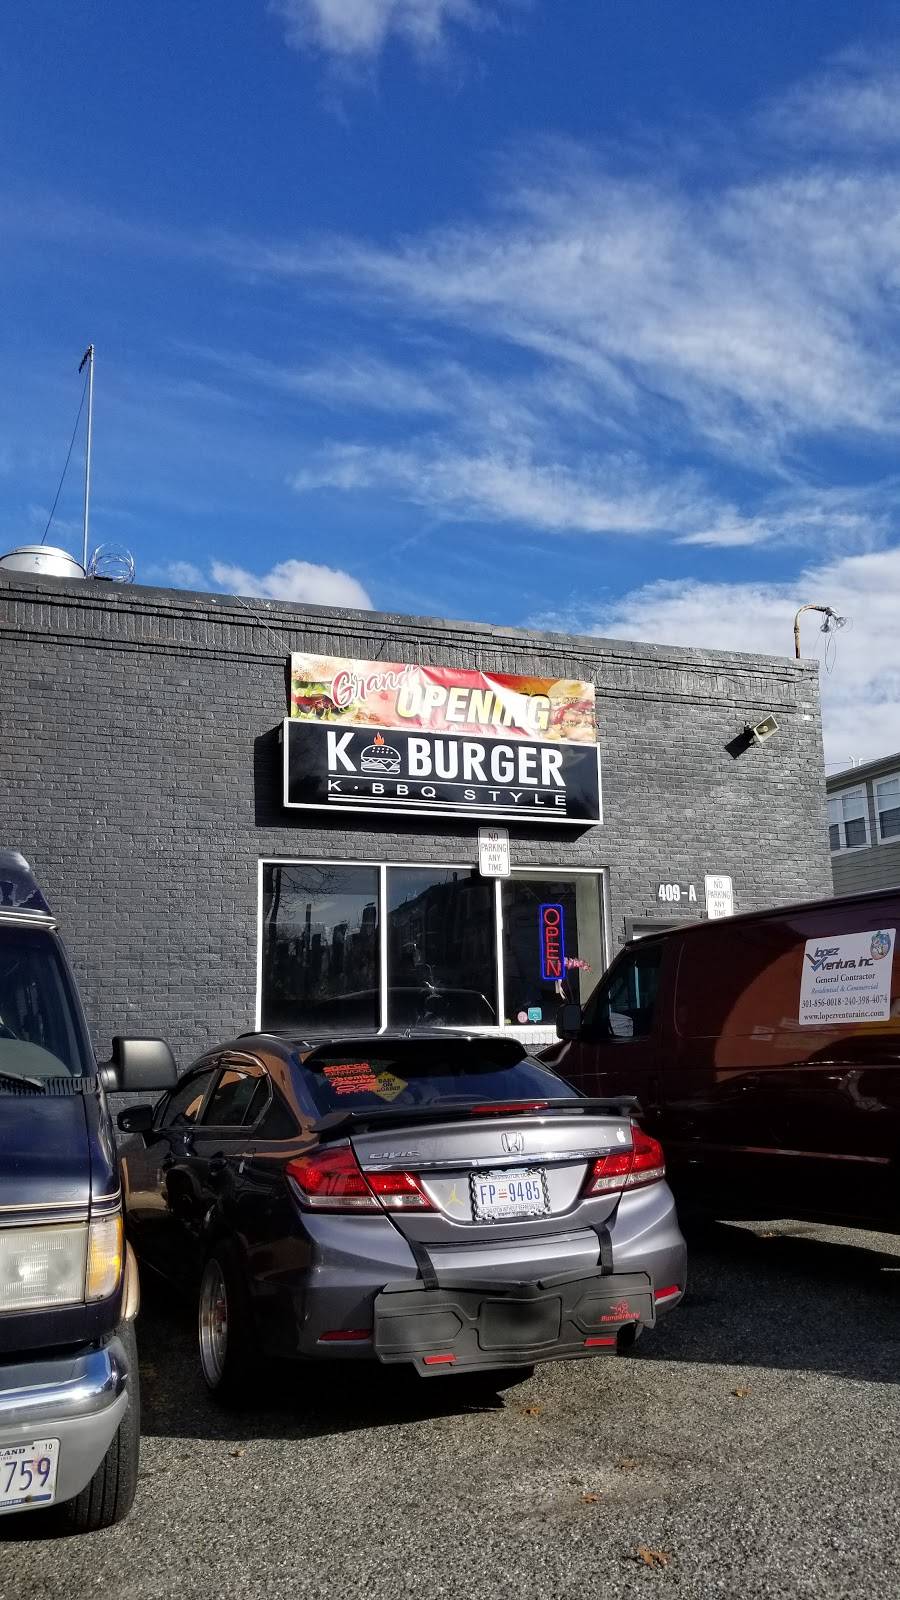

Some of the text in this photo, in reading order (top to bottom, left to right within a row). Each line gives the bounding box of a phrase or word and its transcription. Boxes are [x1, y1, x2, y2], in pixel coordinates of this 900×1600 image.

[332, 665, 415, 708] Grand
[396, 684, 551, 731] OPENING
[327, 731, 567, 787] K BURGER
[463, 789, 567, 806] STYLE
[488, 832, 499, 841] NO
[480, 843, 507, 853] PARKING
[488, 854, 500, 862] ANY
[488, 864, 502, 872] TIME
[713, 880, 723, 889] NO
[658, 884, 697, 901] 409-A
[707, 890, 731, 900] PARKING
[713, 901, 725, 909] ANY
[543, 908, 562, 977] OPEN
[815, 973, 876, 984] General Contractor
[811, 984, 839, 994] Residential
[846, 983, 879, 991] Commercial
[480, 1180, 541, 1205] FP 9485
[5, 1457, 51, 1493] 759
